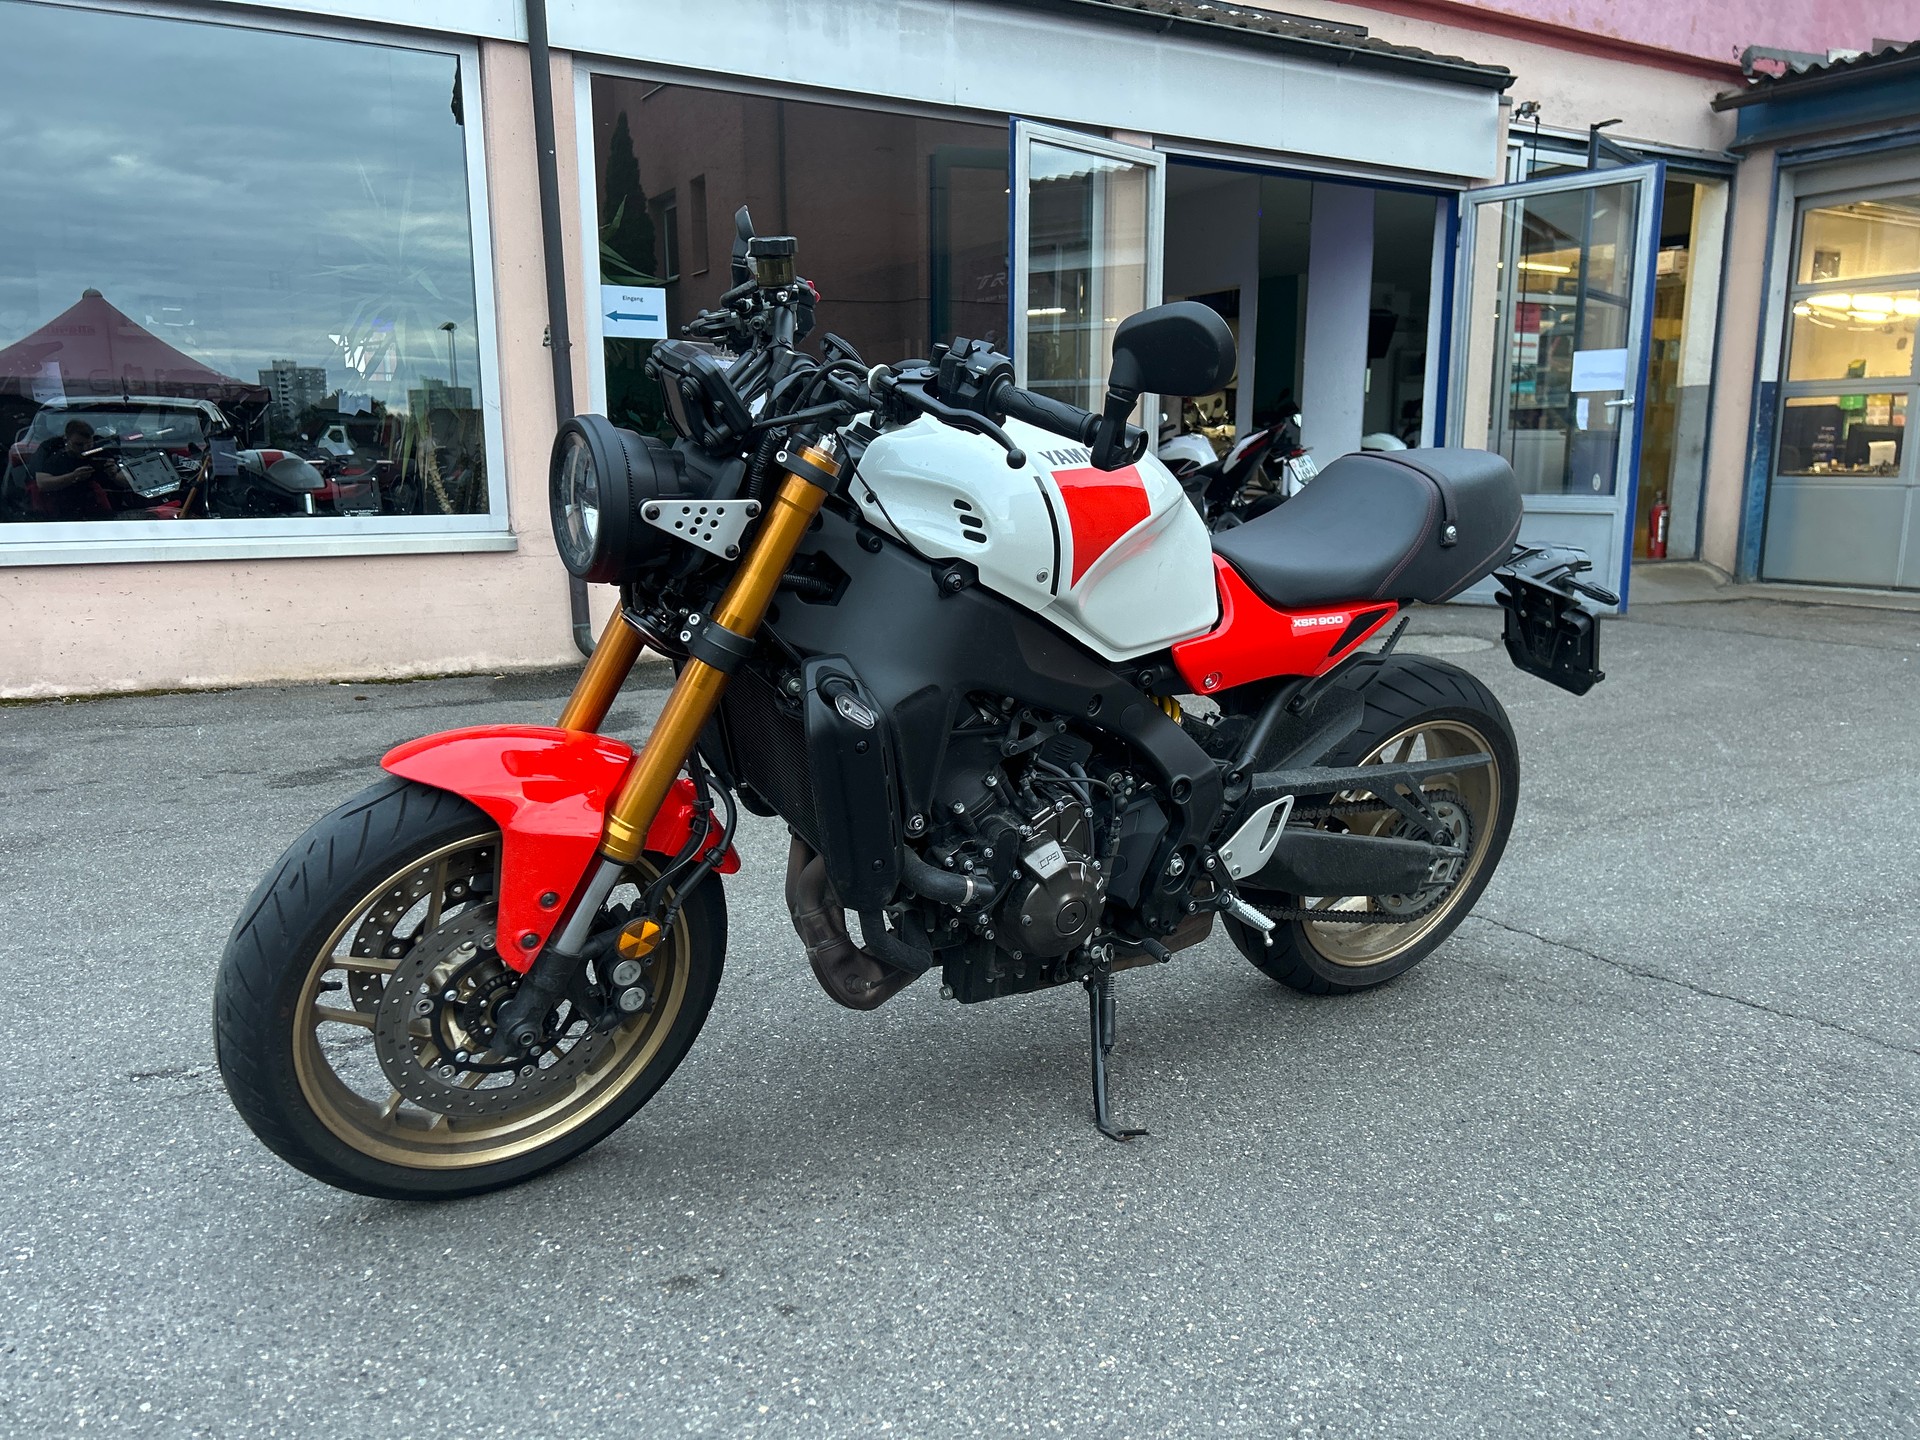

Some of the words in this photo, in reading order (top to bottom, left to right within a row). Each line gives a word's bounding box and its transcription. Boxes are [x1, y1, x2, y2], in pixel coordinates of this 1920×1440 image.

[622, 295, 644, 303] Eingang
[1293, 617, 1318, 628] XSR
[1318, 615, 1344, 625] 900
